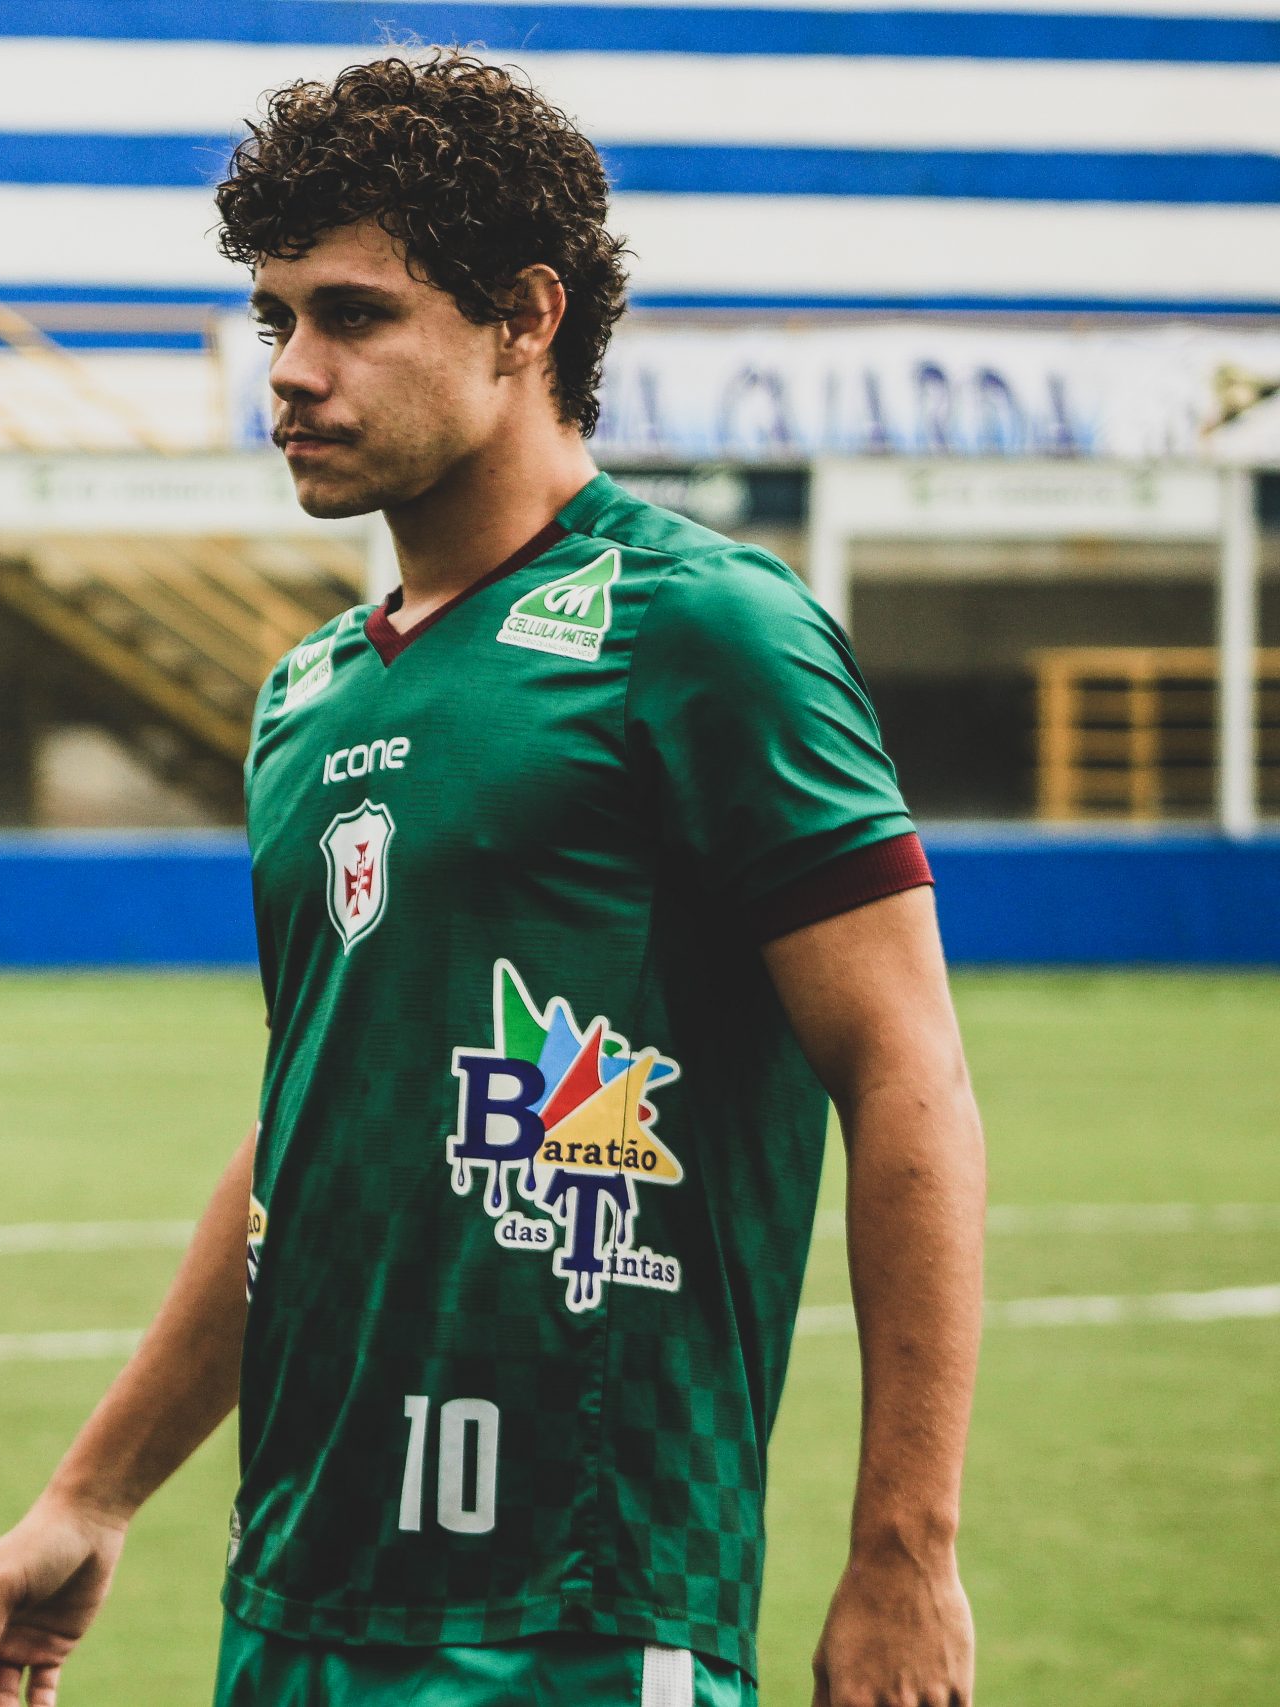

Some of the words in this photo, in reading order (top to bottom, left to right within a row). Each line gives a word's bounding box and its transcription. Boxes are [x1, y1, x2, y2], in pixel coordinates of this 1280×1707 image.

[453, 1055, 657, 1172] Baratão
[502, 1219, 548, 1243] das
[542, 1168, 676, 1284] Tintas
[398, 1394, 500, 1535] 10
